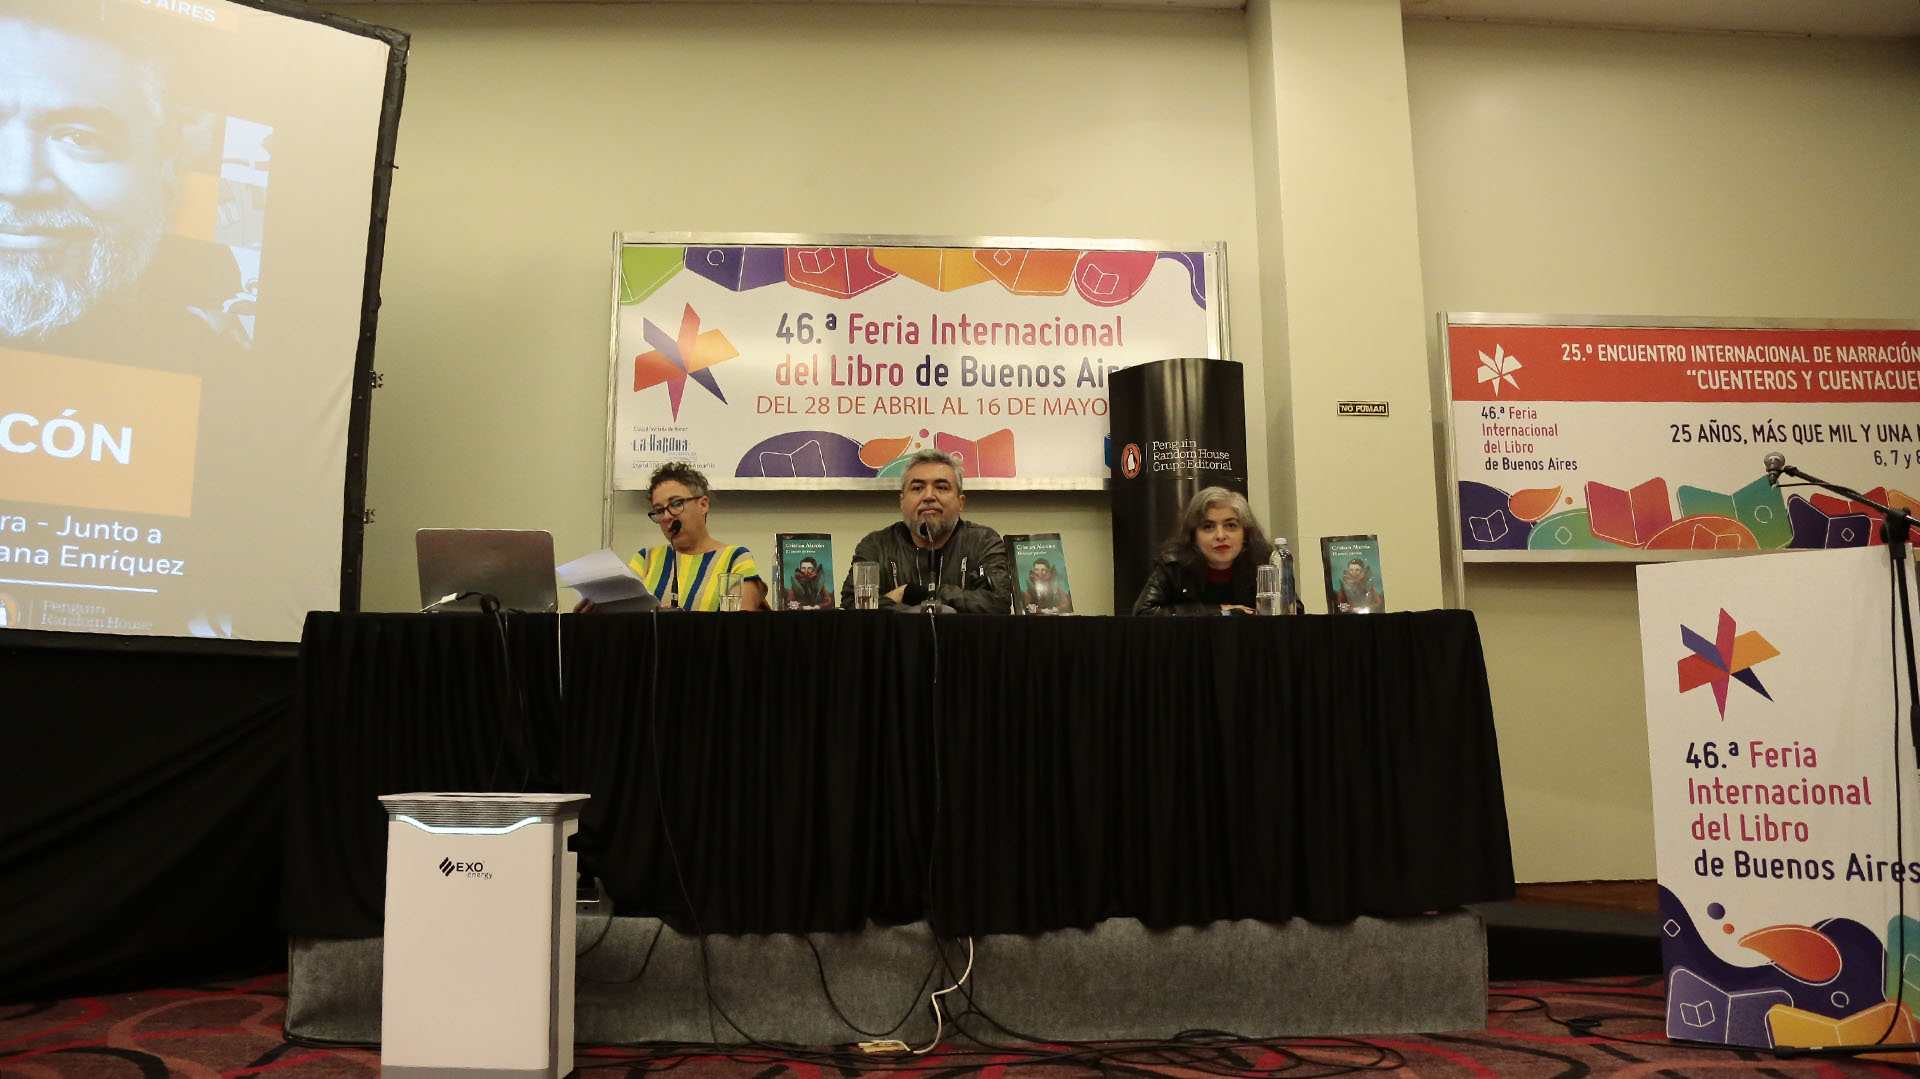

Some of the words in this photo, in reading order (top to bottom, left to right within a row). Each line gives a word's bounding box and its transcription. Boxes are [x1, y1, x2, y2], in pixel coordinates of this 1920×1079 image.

[157, 0, 216, 22] AIRES
[849, 313, 919, 344] Feria
[932, 314, 1122, 346] Internacional
[1598, 344, 1686, 362] ENCUENTRO
[1691, 345, 1810, 362] INTERNACIONAL
[1813, 346, 1832, 363] DE
[1837, 341, 1920, 363] NARRACIÓN
[775, 352, 820, 387] del
[831, 354, 903, 386] Libro
[916, 355, 948, 386] de
[962, 356, 1065, 387] Buenos
[1076, 356, 1131, 388] Air
[1802, 371, 1812, 390] Y
[1818, 370, 1920, 390] CUENTACUE
[757, 396, 797, 413] DEL
[805, 397, 830, 414] 28
[837, 396, 866, 414] DE
[873, 397, 935, 414] ABRIL
[942, 397, 968, 415] AL
[977, 398, 1000, 415] 16
[1008, 398, 1036, 415] DE
[1044, 398, 1108, 416] MAYO
[1509, 407, 1537, 419] Feria
[0, 408, 133, 464] CÓN
[1483, 423, 1558, 436] Internacional
[1670, 424, 1691, 442] 25
[1698, 420, 1747, 444] AÑOS,
[1752, 419, 1787, 442] MÁS
[1793, 424, 1824, 444] QUE
[1829, 424, 1857, 442] MIL
[1861, 424, 1870, 442] Y
[1877, 424, 1912, 442] UNA
[1152, 439, 1197, 451] Penguin
[1153, 449, 1197, 461] Random
[1198, 449, 1230, 460] House
[1484, 440, 1501, 453] del
[1505, 440, 1533, 453] Libro
[1153, 462, 1186, 472] Grupo
[1187, 460, 1233, 471] Editorial
[1485, 457, 1498, 470] de
[1503, 457, 1544, 470] Buenos
[1548, 458, 1577, 470] Aires
[1874, 450, 1887, 466] 6,
[1891, 450, 1898, 465] 7
[1904, 454, 1911, 469] y
[56, 514, 139, 542] Junto
[146, 526, 163, 545] a
[60, 544, 185, 576] Enríquez
[1750, 741, 1816, 768] Feria
[1689, 776, 1871, 805] Internacional
[1692, 813, 1730, 840] del
[1740, 813, 1808, 842] Libro
[456, 862, 483, 872] EXO
[467, 871, 492, 879] energy
[1695, 849, 1724, 877] de
[1735, 850, 1834, 880] Buenos
[1846, 852, 1920, 884] Aires
